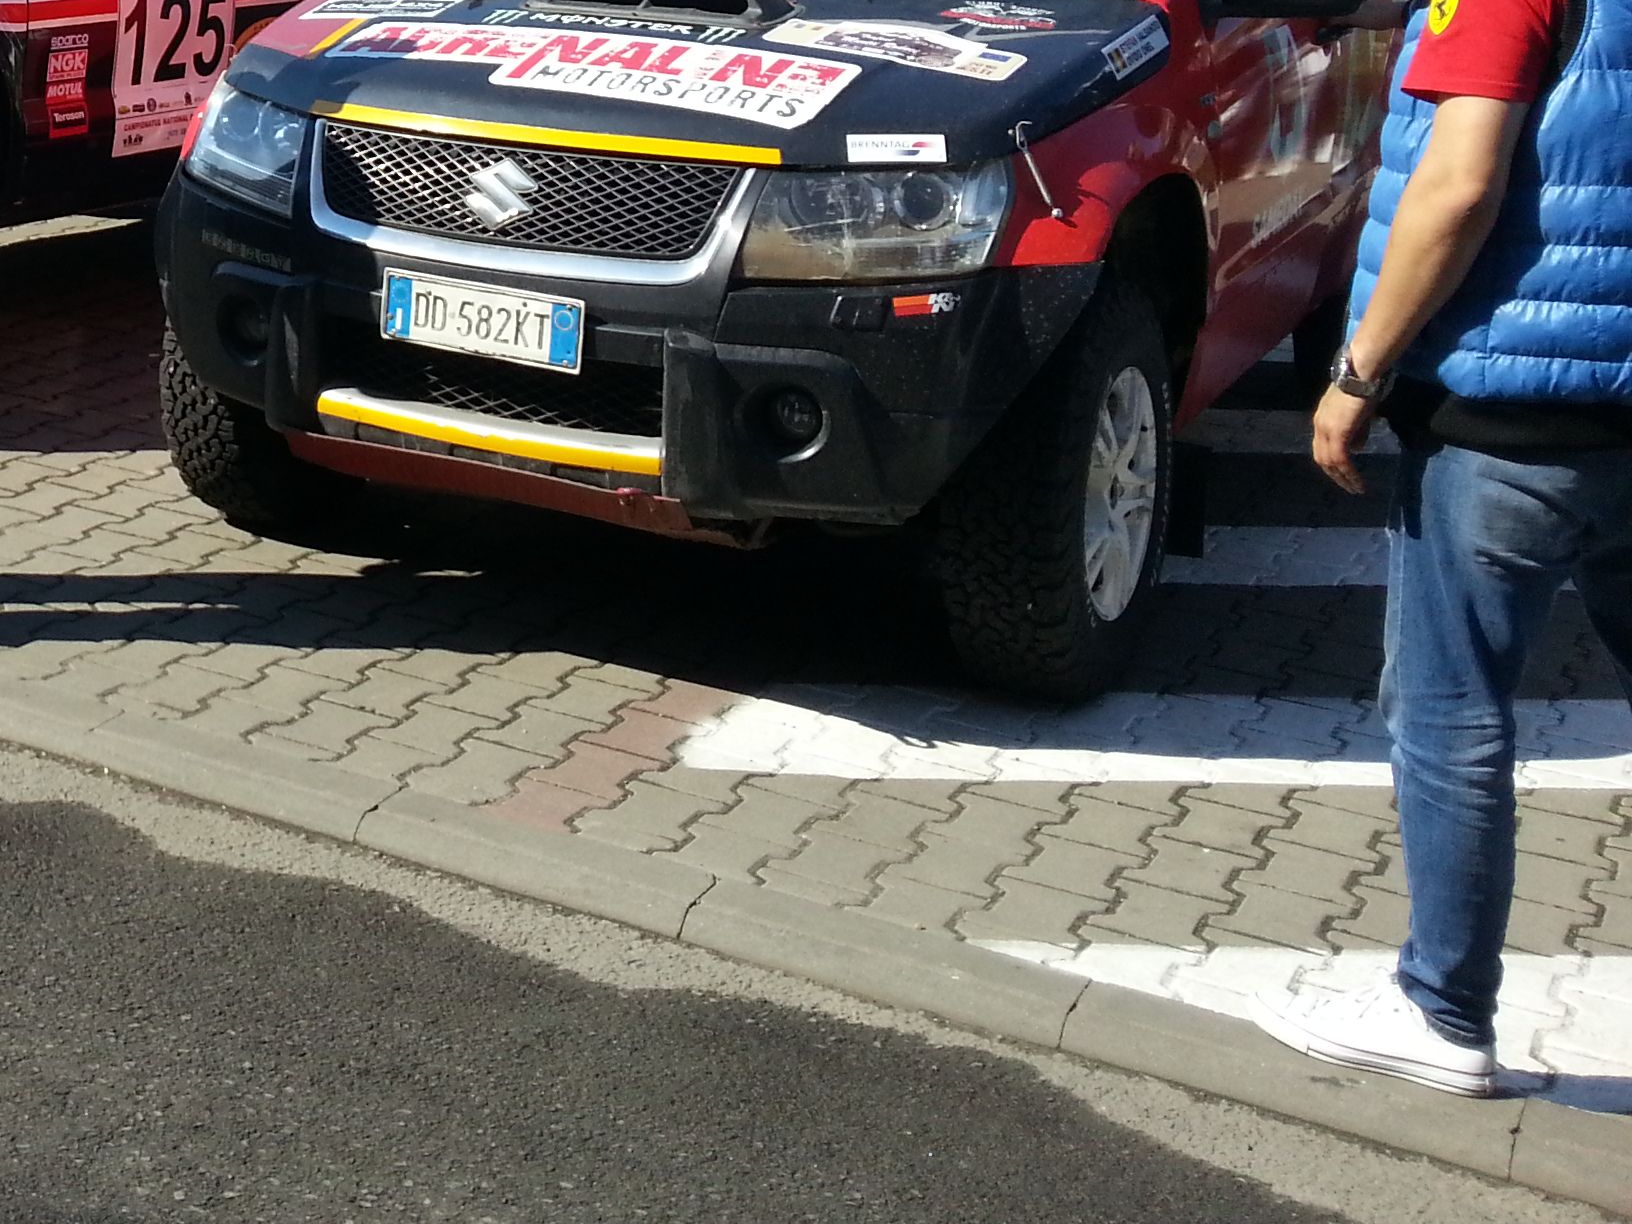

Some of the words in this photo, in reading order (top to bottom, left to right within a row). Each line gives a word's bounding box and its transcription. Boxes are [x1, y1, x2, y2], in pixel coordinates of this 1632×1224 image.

[51, 33, 89, 48] sparco
[50, 52, 86, 74] NGK
[47, 81, 83, 97] MOTUL
[535, 64, 806, 119] MOTORSPORTS
[456, 301, 551, 351] 582KT
